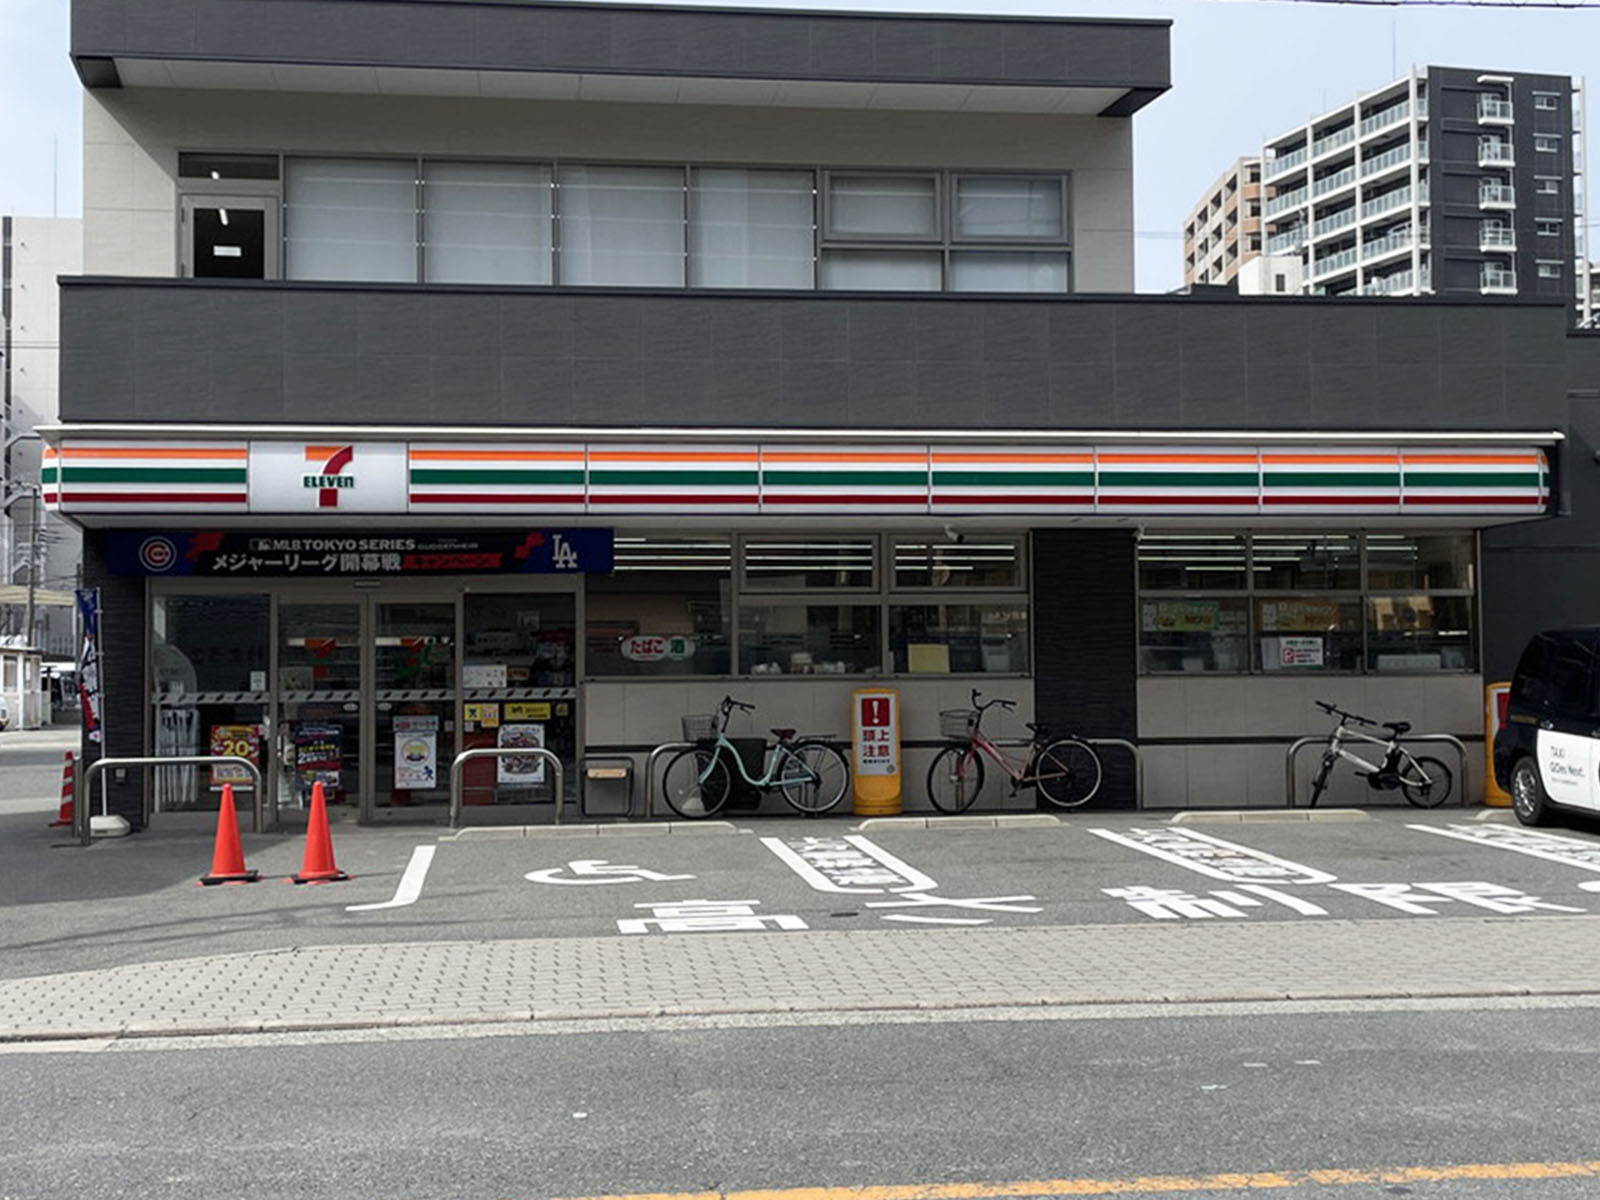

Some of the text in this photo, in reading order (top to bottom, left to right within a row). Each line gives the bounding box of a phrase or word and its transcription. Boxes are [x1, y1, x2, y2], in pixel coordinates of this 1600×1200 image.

[304, 445, 353, 507] 7
[303, 539, 355, 550] TOKYO
[359, 539, 415, 550] SERIES
[630, 639, 665, 654] たばこ
[863, 729, 889, 742] 頭上
[223, 740, 249, 756] 20
[863, 745, 890, 757] 注意
